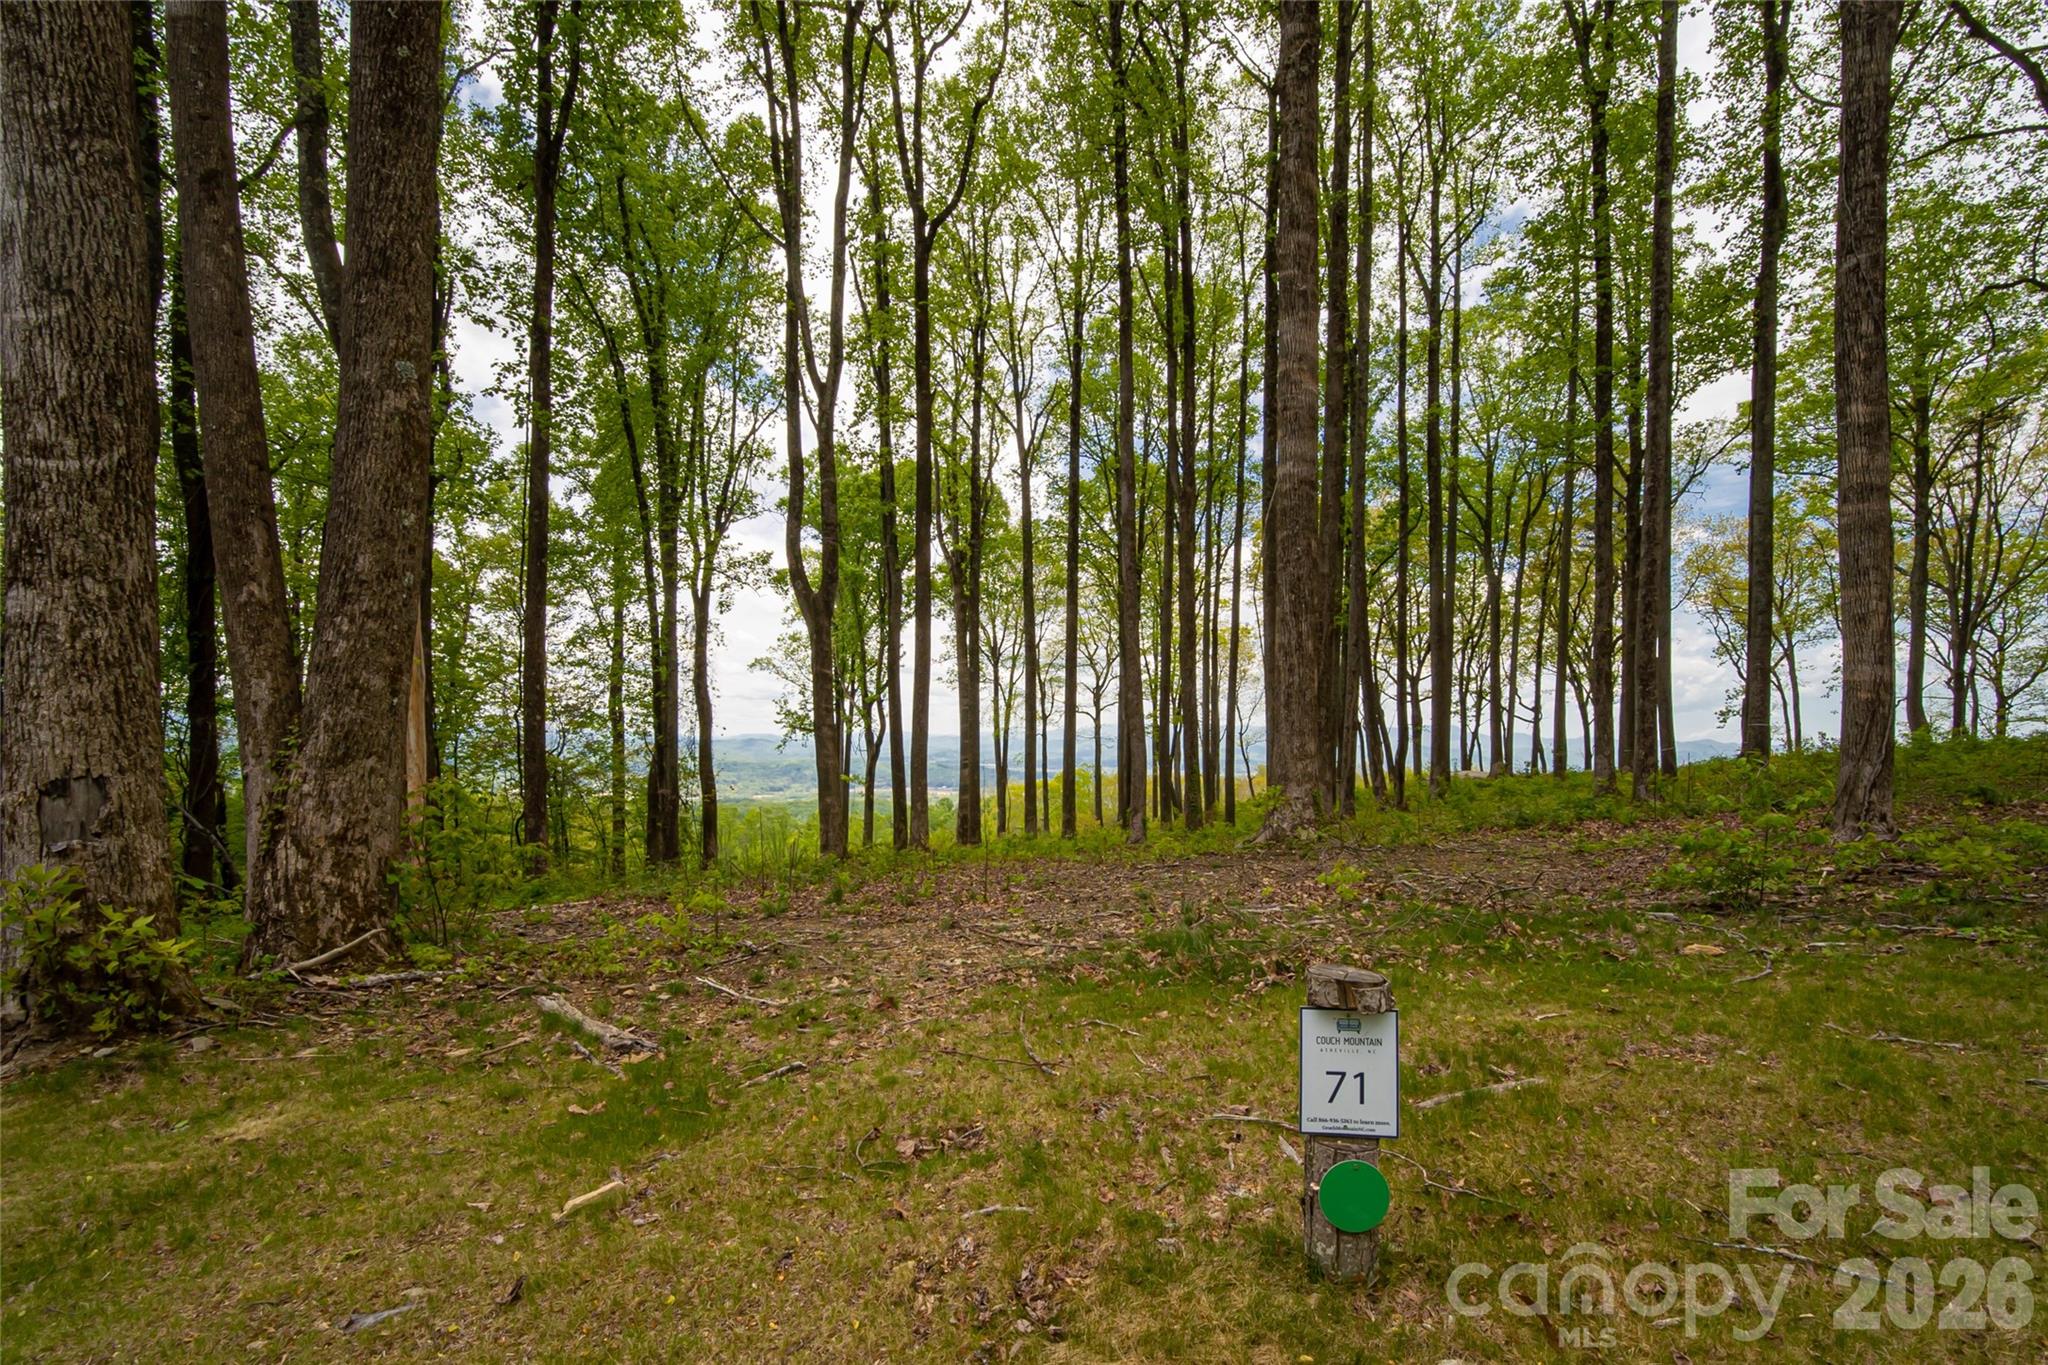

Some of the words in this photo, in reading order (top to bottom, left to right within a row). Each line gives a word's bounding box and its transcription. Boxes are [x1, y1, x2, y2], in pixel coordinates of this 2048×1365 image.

[1315, 1036, 1340, 1045] COUCH
[1343, 1036, 1383, 1046] MOUNTAIN
[1325, 1070, 1365, 1105] 71
